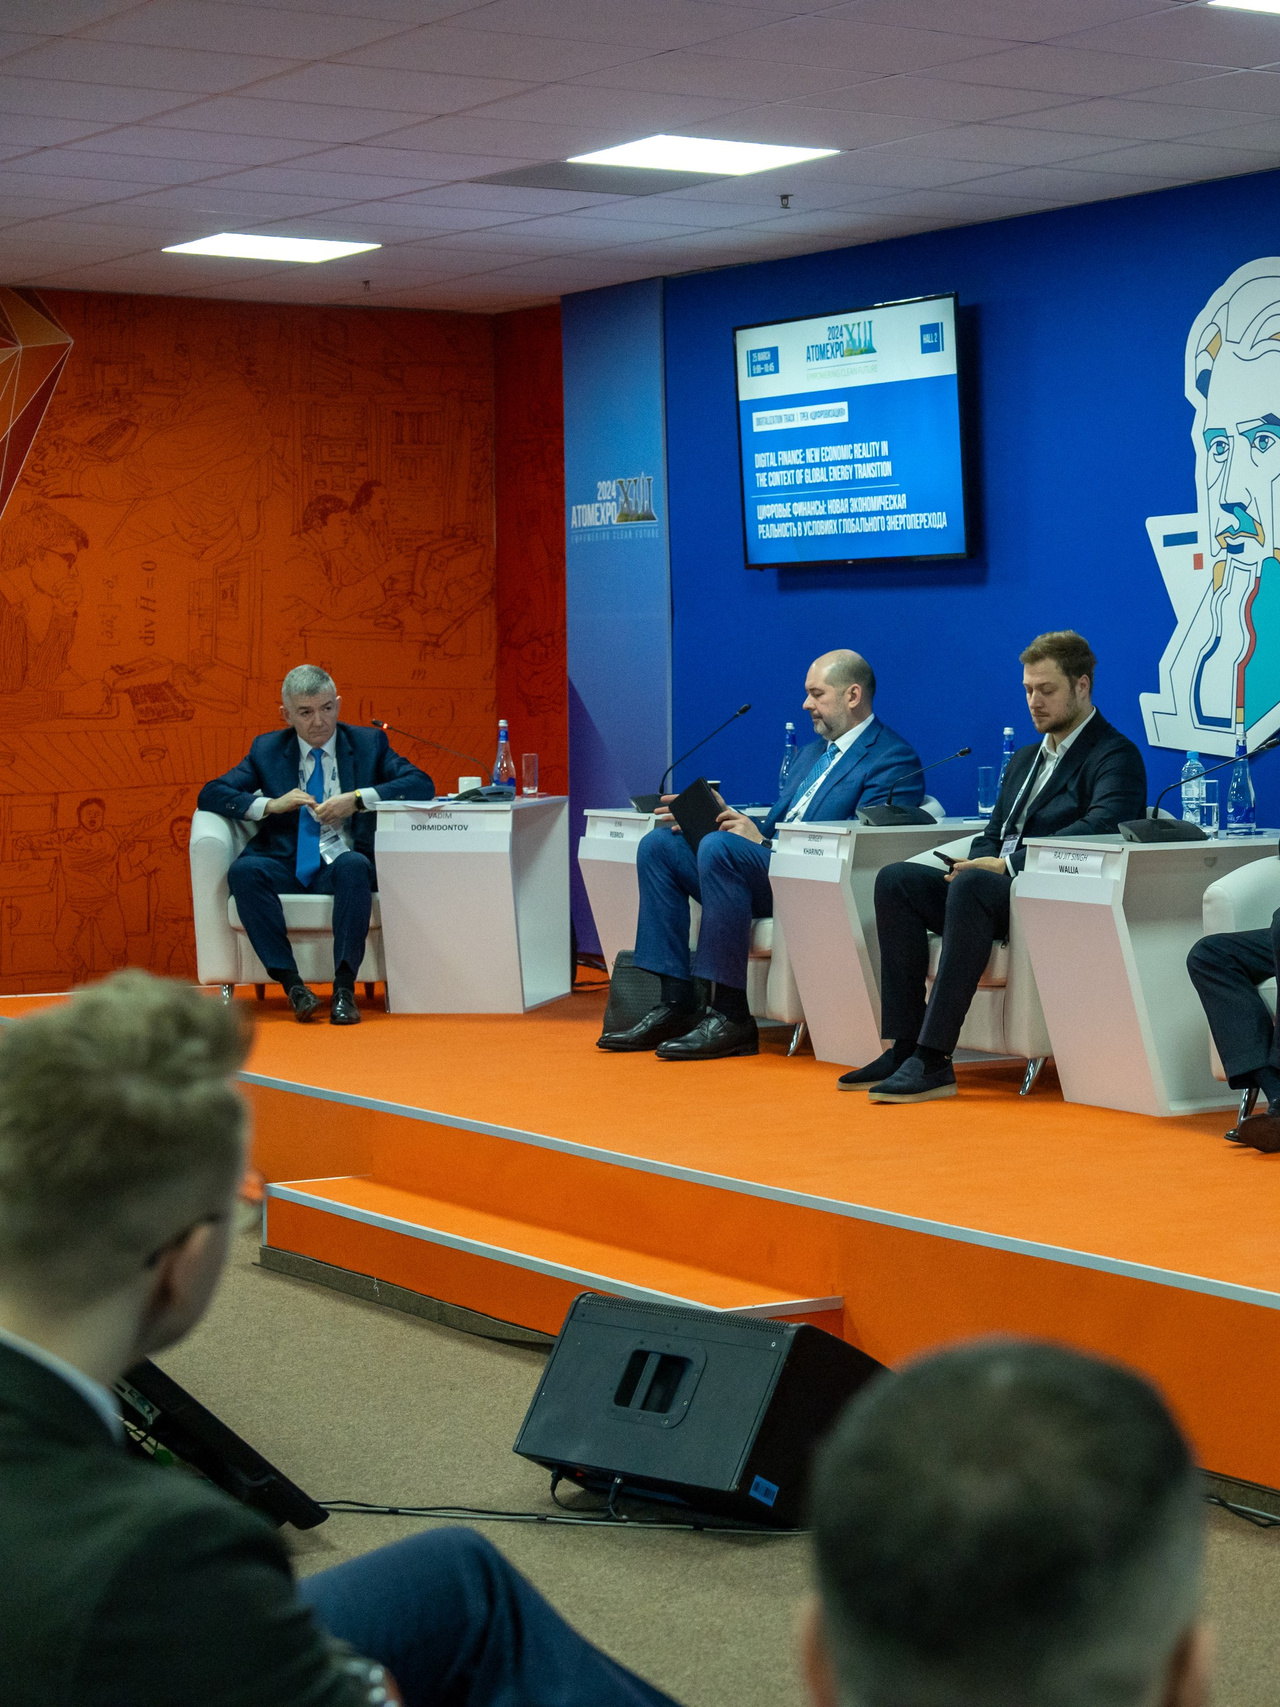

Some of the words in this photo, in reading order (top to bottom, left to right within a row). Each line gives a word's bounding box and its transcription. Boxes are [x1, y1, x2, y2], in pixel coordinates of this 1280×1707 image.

[828, 324, 843, 340] 2024
[806, 341, 844, 362] ATOMEXPO
[754, 452, 777, 468] DIGITAL
[778, 449, 805, 466] FINANCE:
[806, 448, 820, 464] NEW
[821, 444, 853, 462] ECONOMIC
[854, 442, 880, 458] REALITY
[881, 440, 888, 456] IN
[756, 472, 768, 488] THE
[768, 470, 794, 487] CONTEXT
[796, 469, 803, 484] OF
[805, 467, 828, 484] GLOBAL
[829, 464, 853, 482] ENERGY
[854, 461, 892, 480] TRANSITION
[597, 480, 616, 500] 2024
[571, 502, 617, 528] ATOMEXPO
[757, 503, 792, 520] ЦИФРОВЫЕ
[792, 500, 826, 517] ФИНАНСЫ:
[828, 498, 849, 514] НОВАЯ
[850, 493, 907, 513] ЭКОНОМИЧЕСКАЯ
[758, 522, 797, 539] РЕАЛЬНОСТЬ
[803, 519, 838, 536] УСЛОВИЯХ
[839, 516, 886, 534] ГЛОБАЛЬНОГО
[887, 511, 947, 531] ЭНЕРГОПЕРЕХОДА
